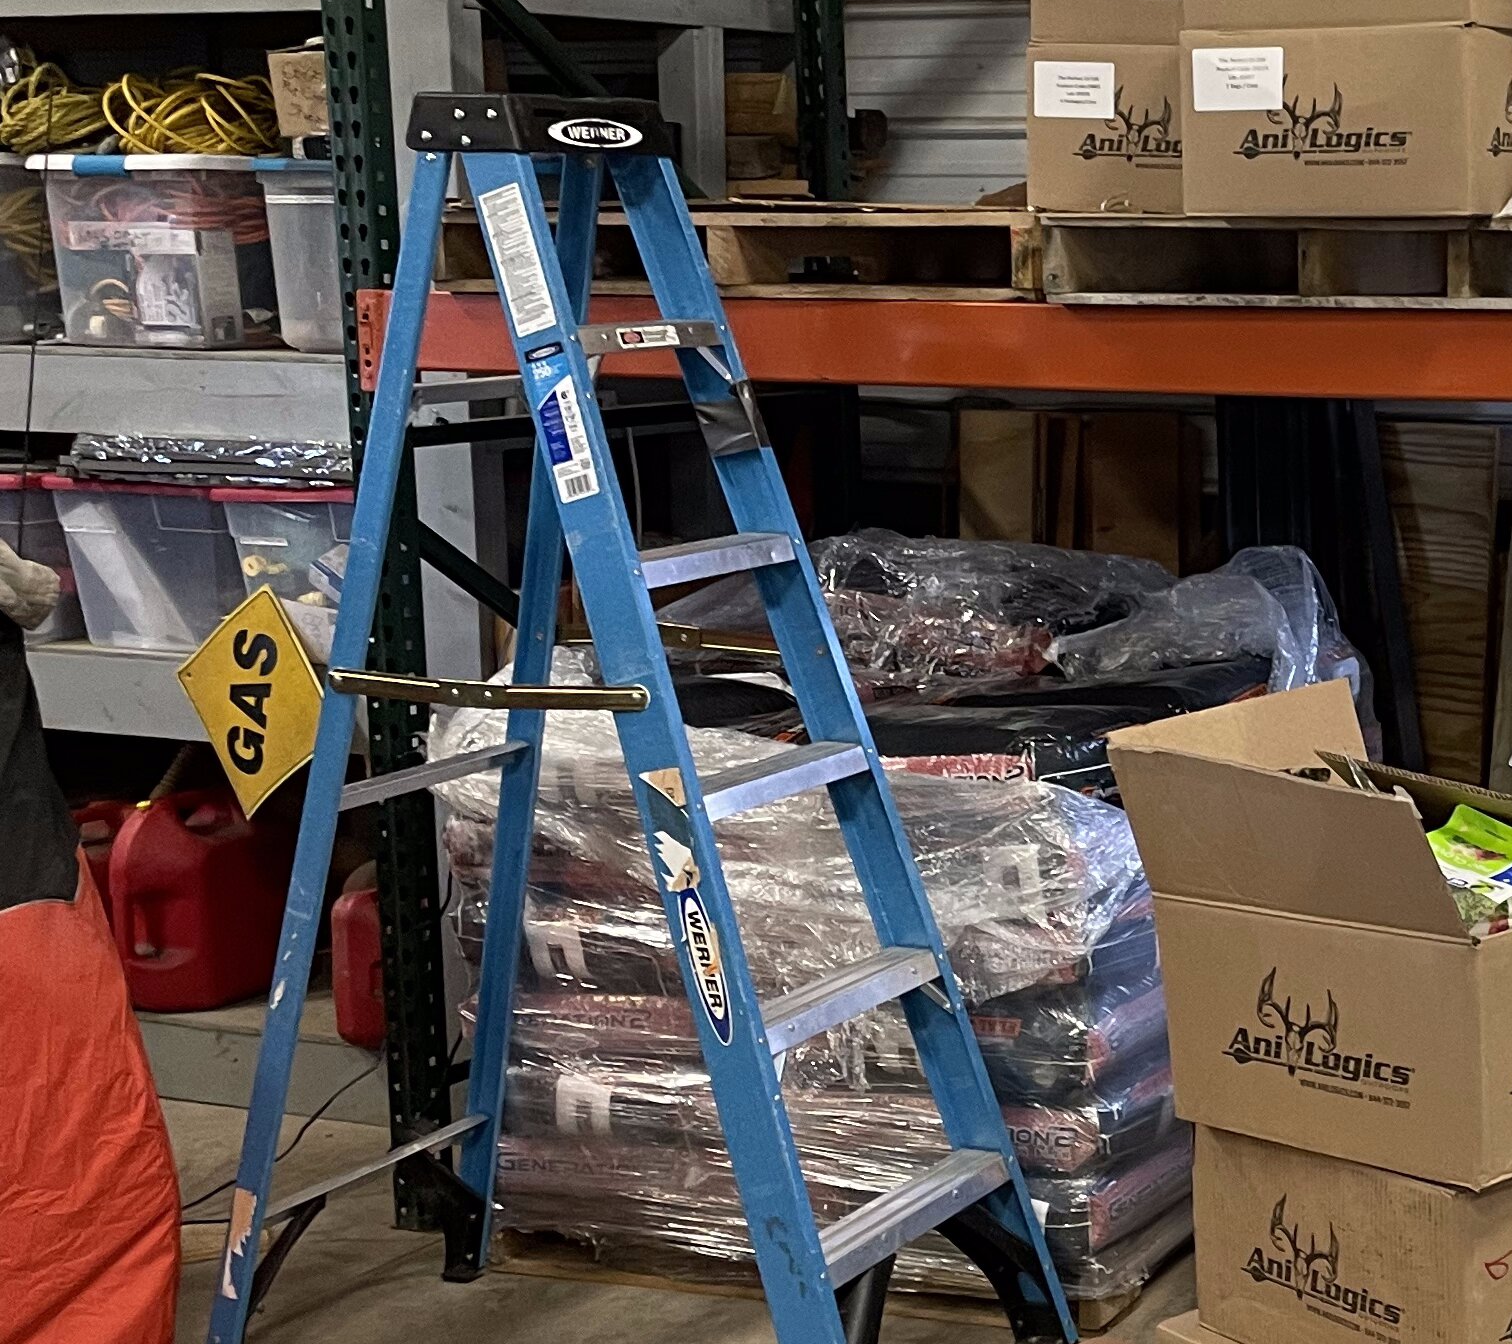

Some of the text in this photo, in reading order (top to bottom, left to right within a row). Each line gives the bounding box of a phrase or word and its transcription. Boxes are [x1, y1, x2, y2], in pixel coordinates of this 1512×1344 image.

[226, 628, 278, 776] GAS
[1304, 1040, 1411, 1086] Logics
[1310, 1269, 1402, 1325] Logics
